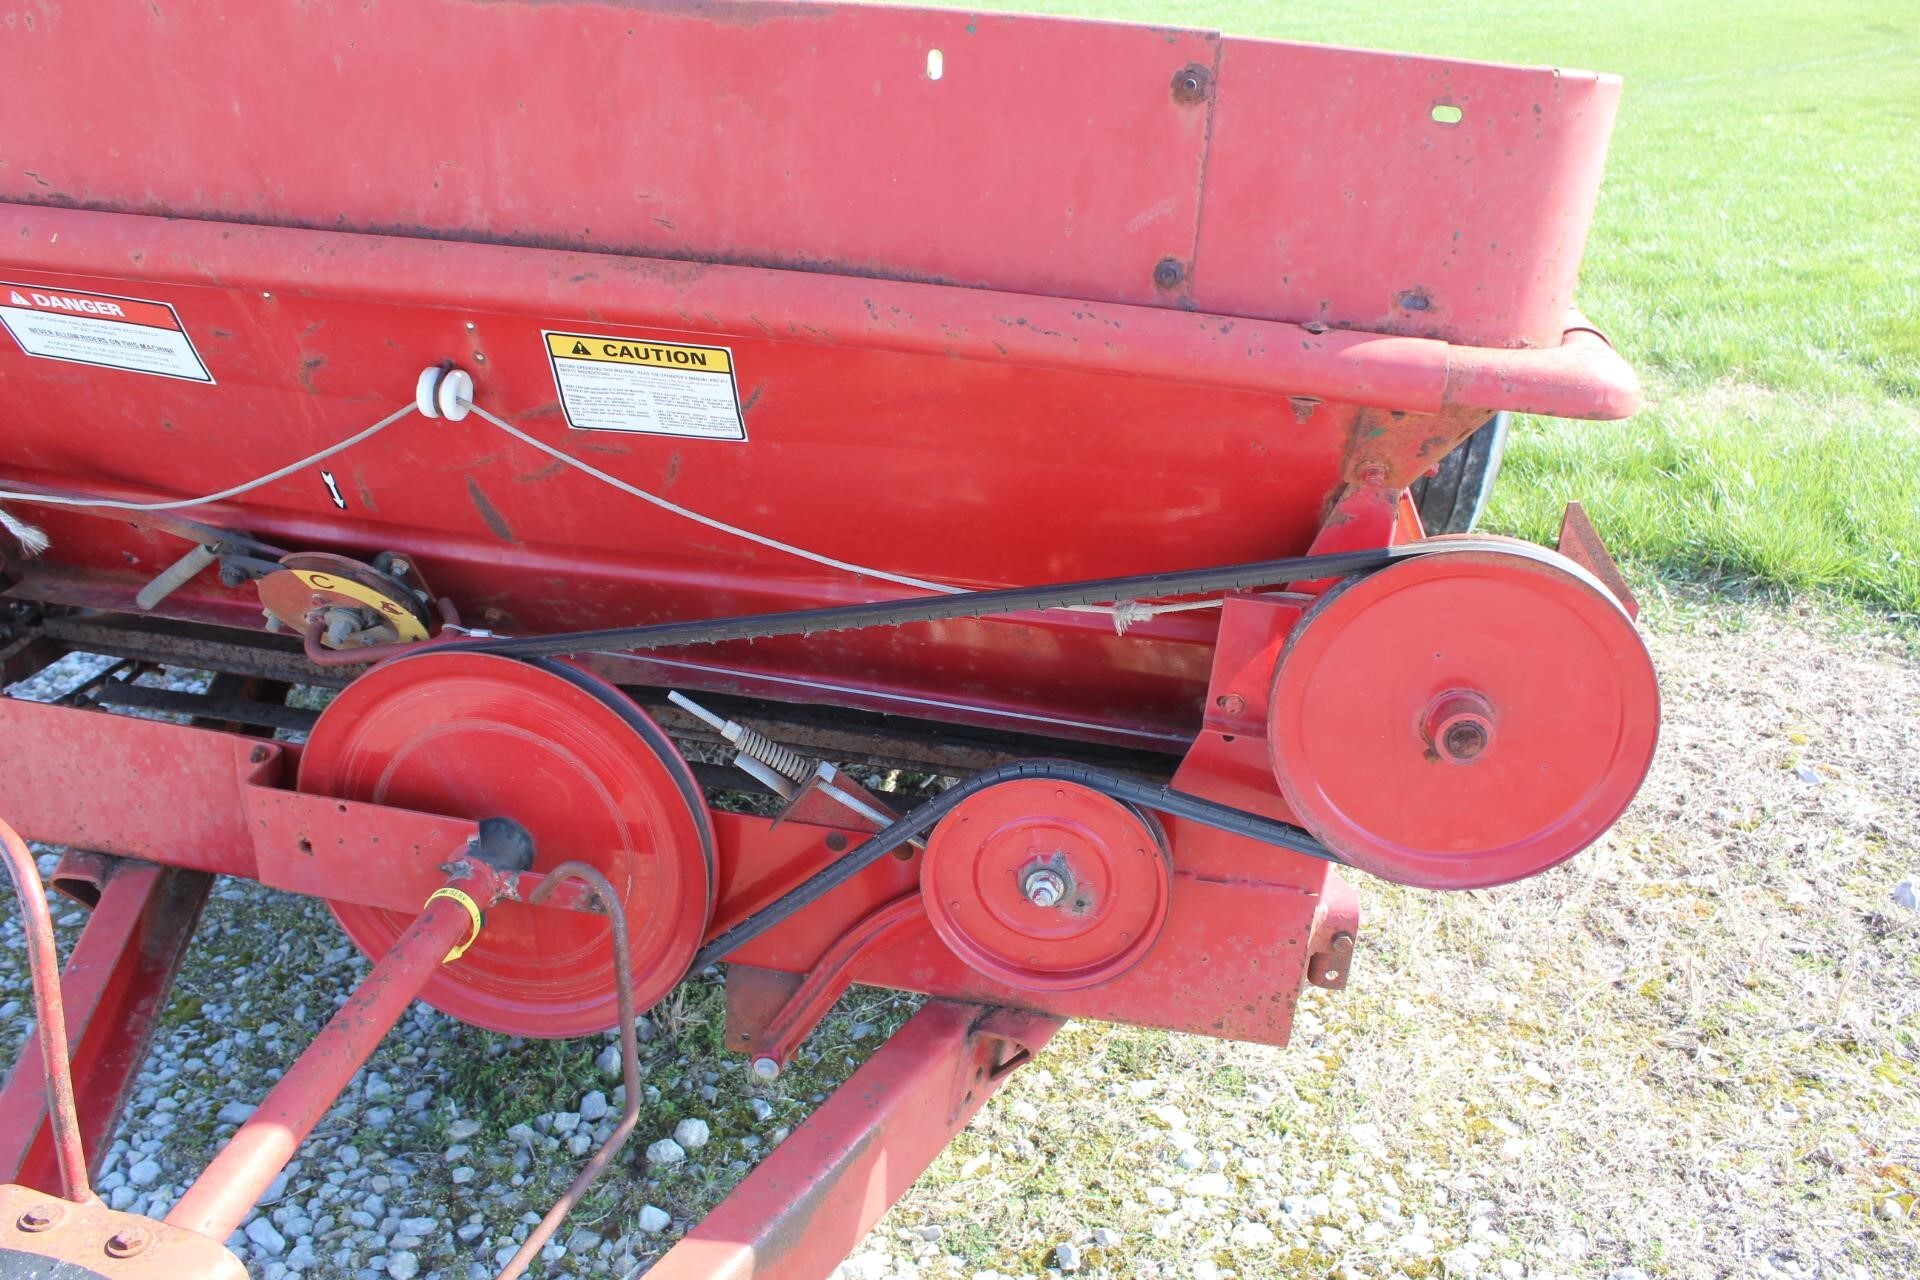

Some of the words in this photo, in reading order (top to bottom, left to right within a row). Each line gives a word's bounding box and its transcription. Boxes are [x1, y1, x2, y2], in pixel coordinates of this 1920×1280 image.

[32, 293, 125, 317] DANGER
[29, 328, 53, 336] NEVER
[55, 331, 79, 340] ALLOW
[80, 334, 108, 344] RIDERS
[109, 338, 121, 346] ON
[122, 340, 138, 348] THIS
[140, 343, 175, 353] MACHINE
[602, 344, 707, 366] CAUTION
[310, 575, 335, 589] C
